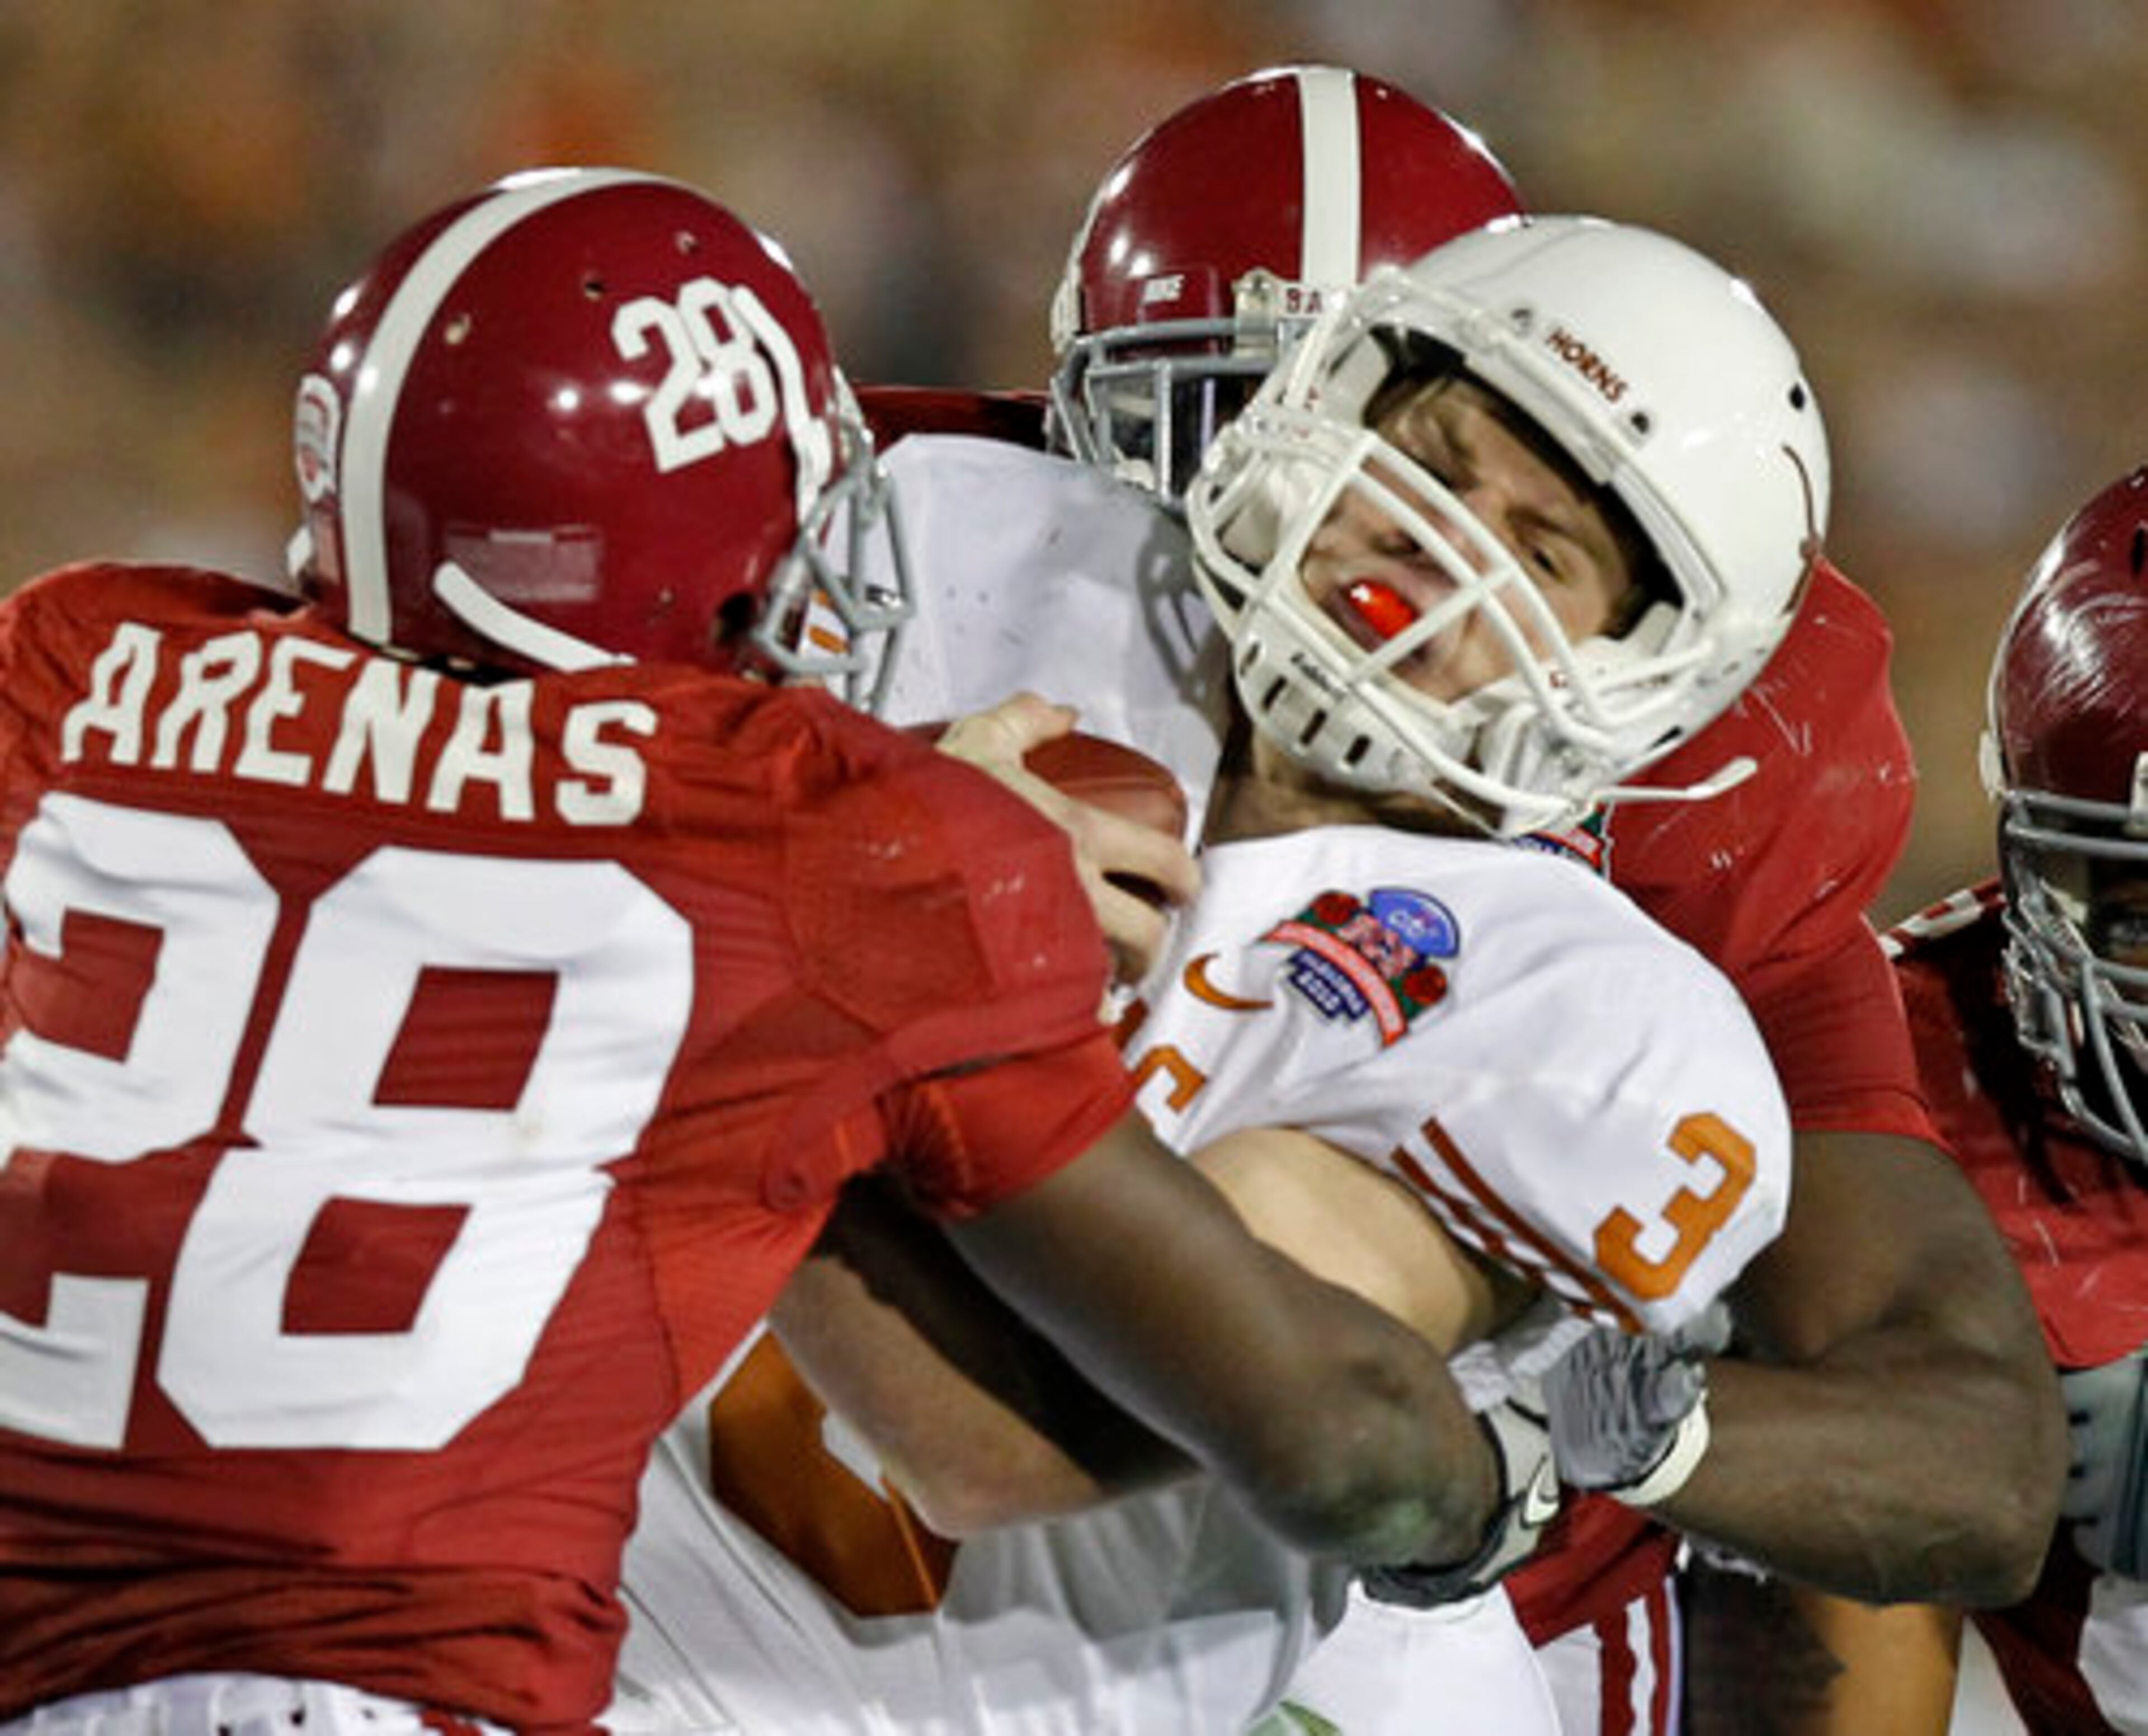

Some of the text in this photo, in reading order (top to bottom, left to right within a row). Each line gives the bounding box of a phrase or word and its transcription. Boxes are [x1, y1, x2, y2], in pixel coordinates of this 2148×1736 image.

[612, 276, 778, 473] 28
[1547, 328, 1627, 403] HORNS
[60, 620, 658, 826] ARENAS
[0, 790, 695, 1450] 28
[1593, 1112, 1756, 1301] 3
